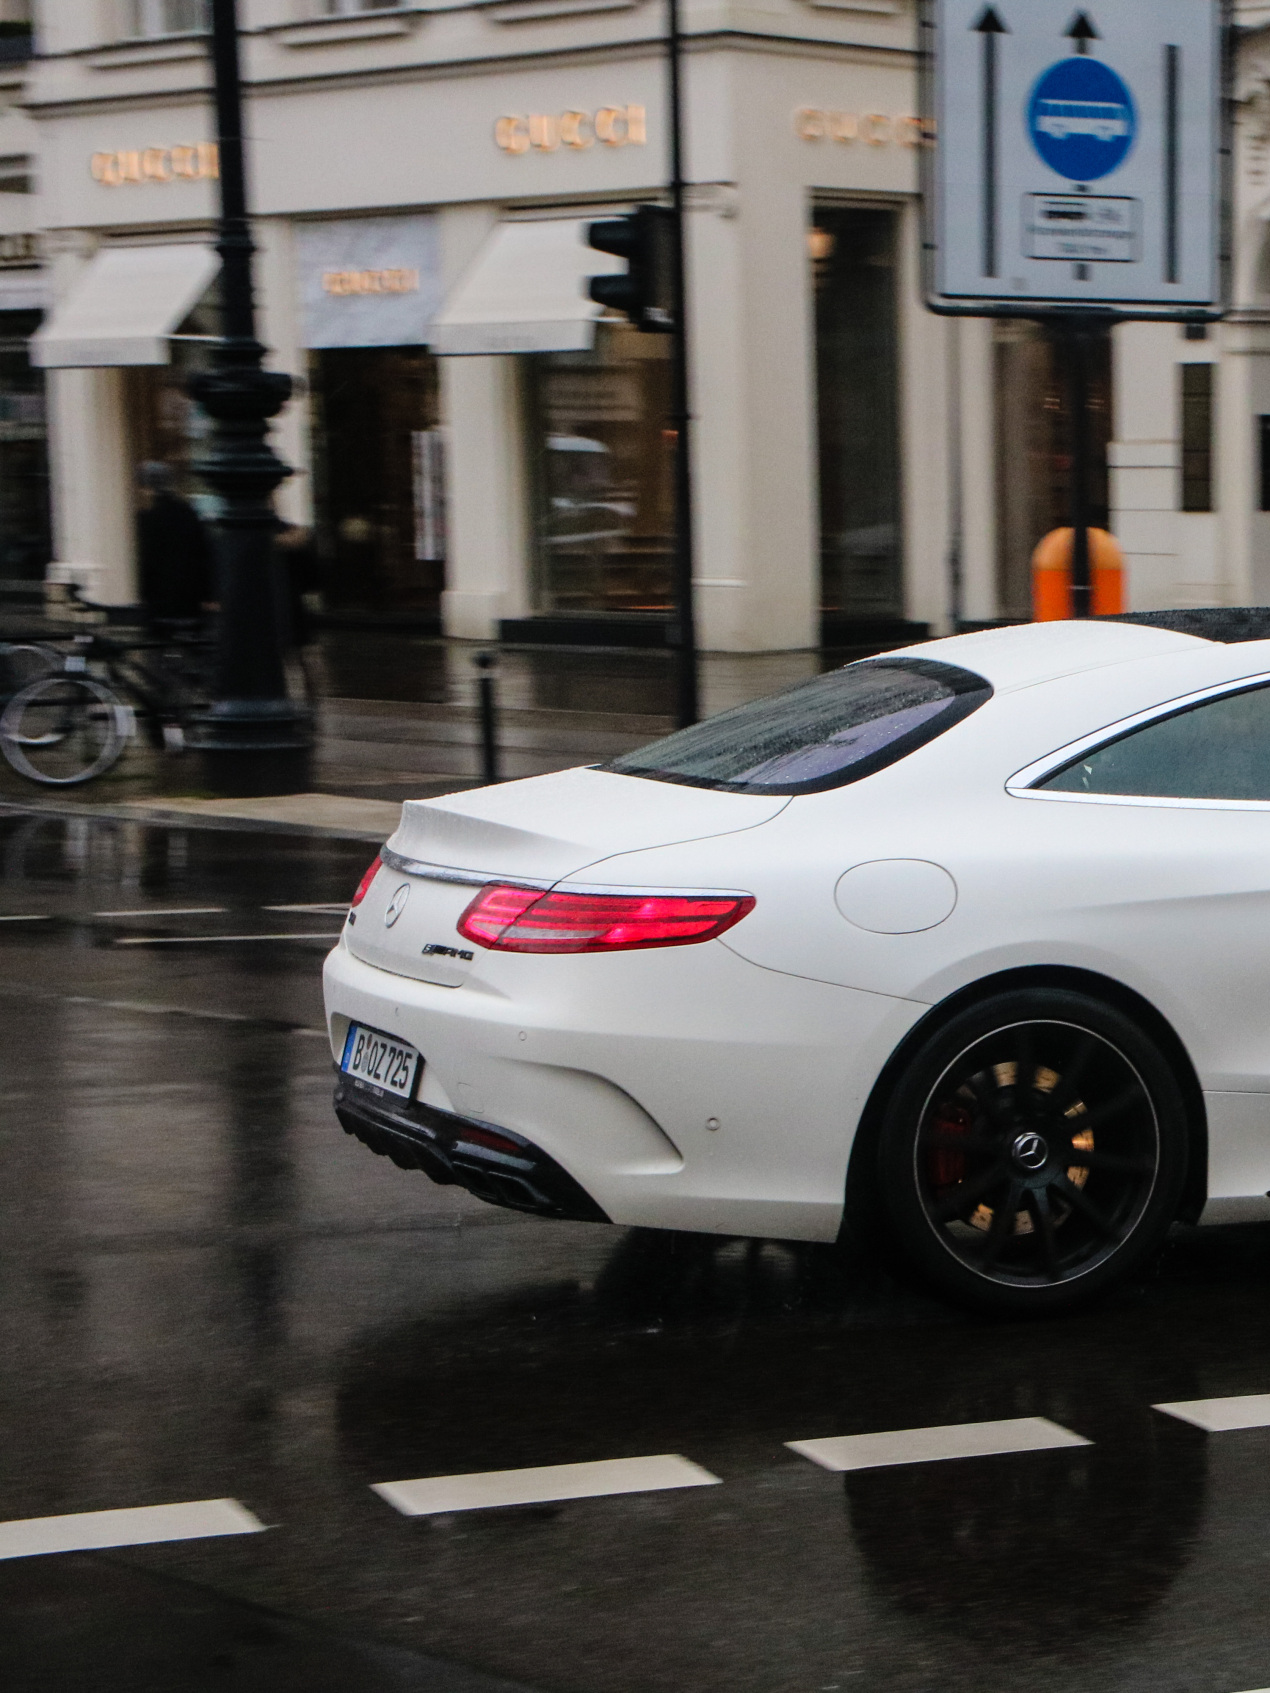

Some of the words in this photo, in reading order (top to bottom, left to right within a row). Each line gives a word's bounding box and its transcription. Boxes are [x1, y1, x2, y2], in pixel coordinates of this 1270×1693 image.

[495, 104, 646, 154] GUCCI
[352, 1034, 366, 1071] B
[366, 1040, 388, 1080] OZ
[383, 1046, 413, 1090] 725
